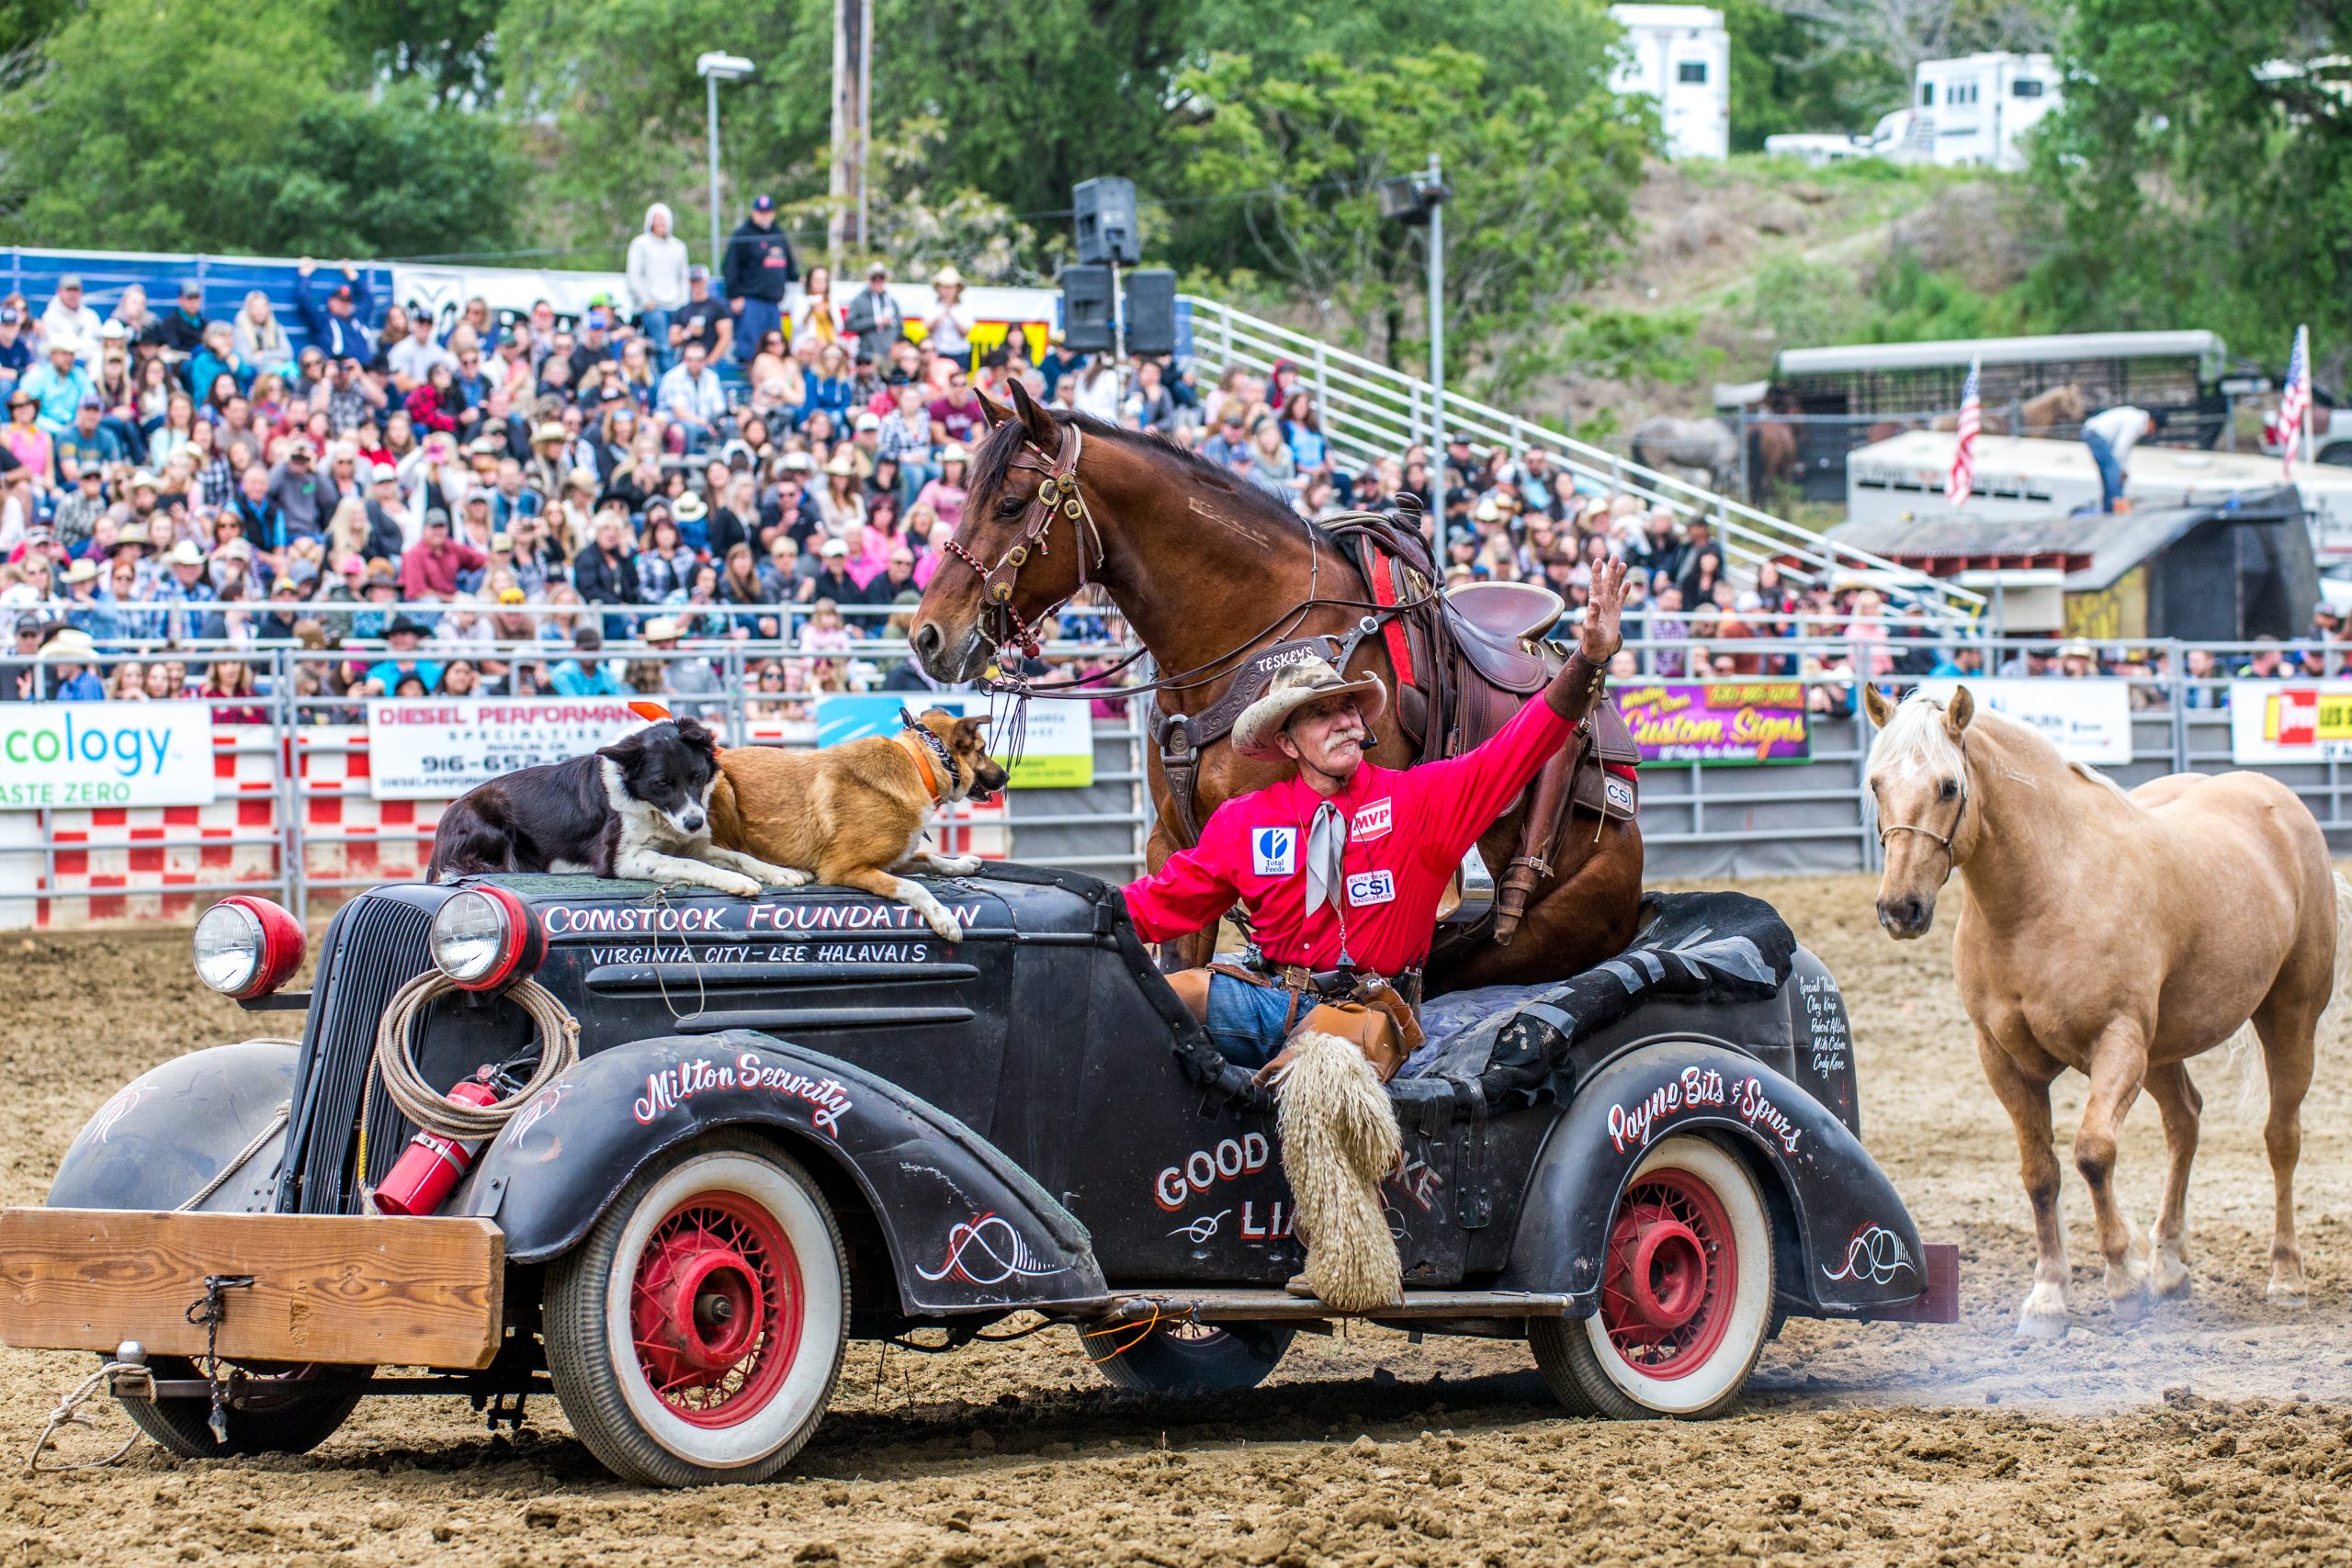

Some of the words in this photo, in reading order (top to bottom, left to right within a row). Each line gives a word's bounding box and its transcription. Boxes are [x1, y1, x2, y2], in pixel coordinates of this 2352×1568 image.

[1257, 646, 1314, 672] TESKEY'S
[379, 706, 467, 726] DIESEL
[479, 705, 641, 725] PERFORMAN
[0, 711, 172, 777] cology
[447, 728, 602, 741] SPECIALTIES
[1624, 707, 1724, 746] Custom
[1730, 705, 1806, 761] Signs
[64, 782, 131, 803] ZERO
[1608, 784, 1632, 807] CSI
[1353, 808, 1390, 831] MVP
[1351, 878, 1391, 898] CSI
[1370, 873, 1389, 881] TEAM
[544, 905, 729, 933] COMSTOCK
[748, 903, 982, 931] FOUNDATIN
[591, 945, 695, 964] VIRGINIA
[818, 943, 928, 963] HALAVAIS
[1799, 976, 1821, 999] Special
[1807, 994, 1822, 1017] Clay
[1811, 1018, 1830, 1033] Robert
[1830, 1016, 1846, 1033] Allen
[1813, 1036, 1828, 1052] Mike
[1813, 1053, 1829, 1080] Cody
[634, 1058, 737, 1125] Milton
[735, 1053, 853, 1138] Security
[1608, 1081, 1683, 1154] Payne
[1680, 1066, 1725, 1109] Bits
[1731, 1079, 1744, 1105] &
[1740, 1076, 1802, 1155] Spurs
[1155, 1132, 1270, 1212] GOOD
[1385, 1149, 1444, 1212] KE
